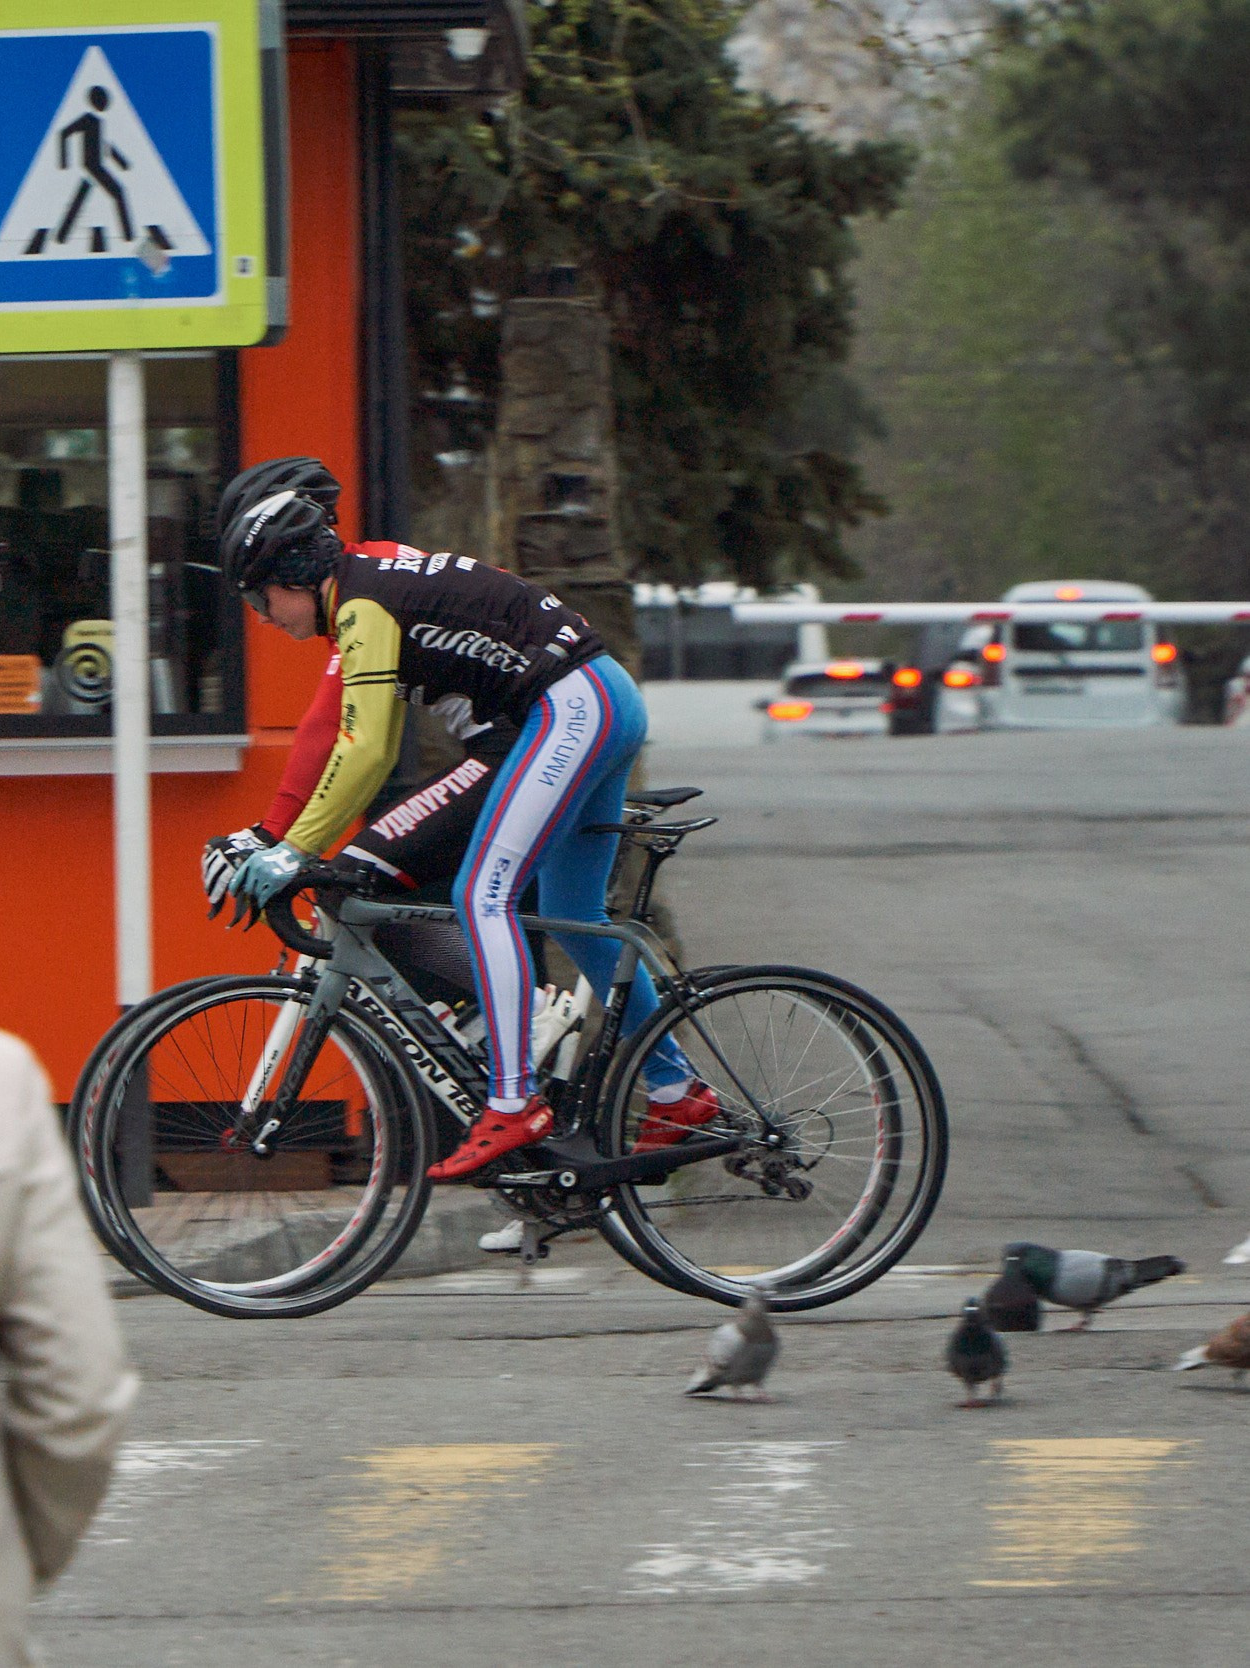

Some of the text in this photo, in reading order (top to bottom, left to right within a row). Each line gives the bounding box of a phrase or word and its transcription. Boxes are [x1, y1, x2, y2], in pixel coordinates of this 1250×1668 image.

[409, 623, 527, 674] Wilier
[537, 696, 588, 787] ИМПУЛЬС
[370, 757, 491, 841] УДМУРТИЯ
[345, 982, 482, 1119] ARGON 18
